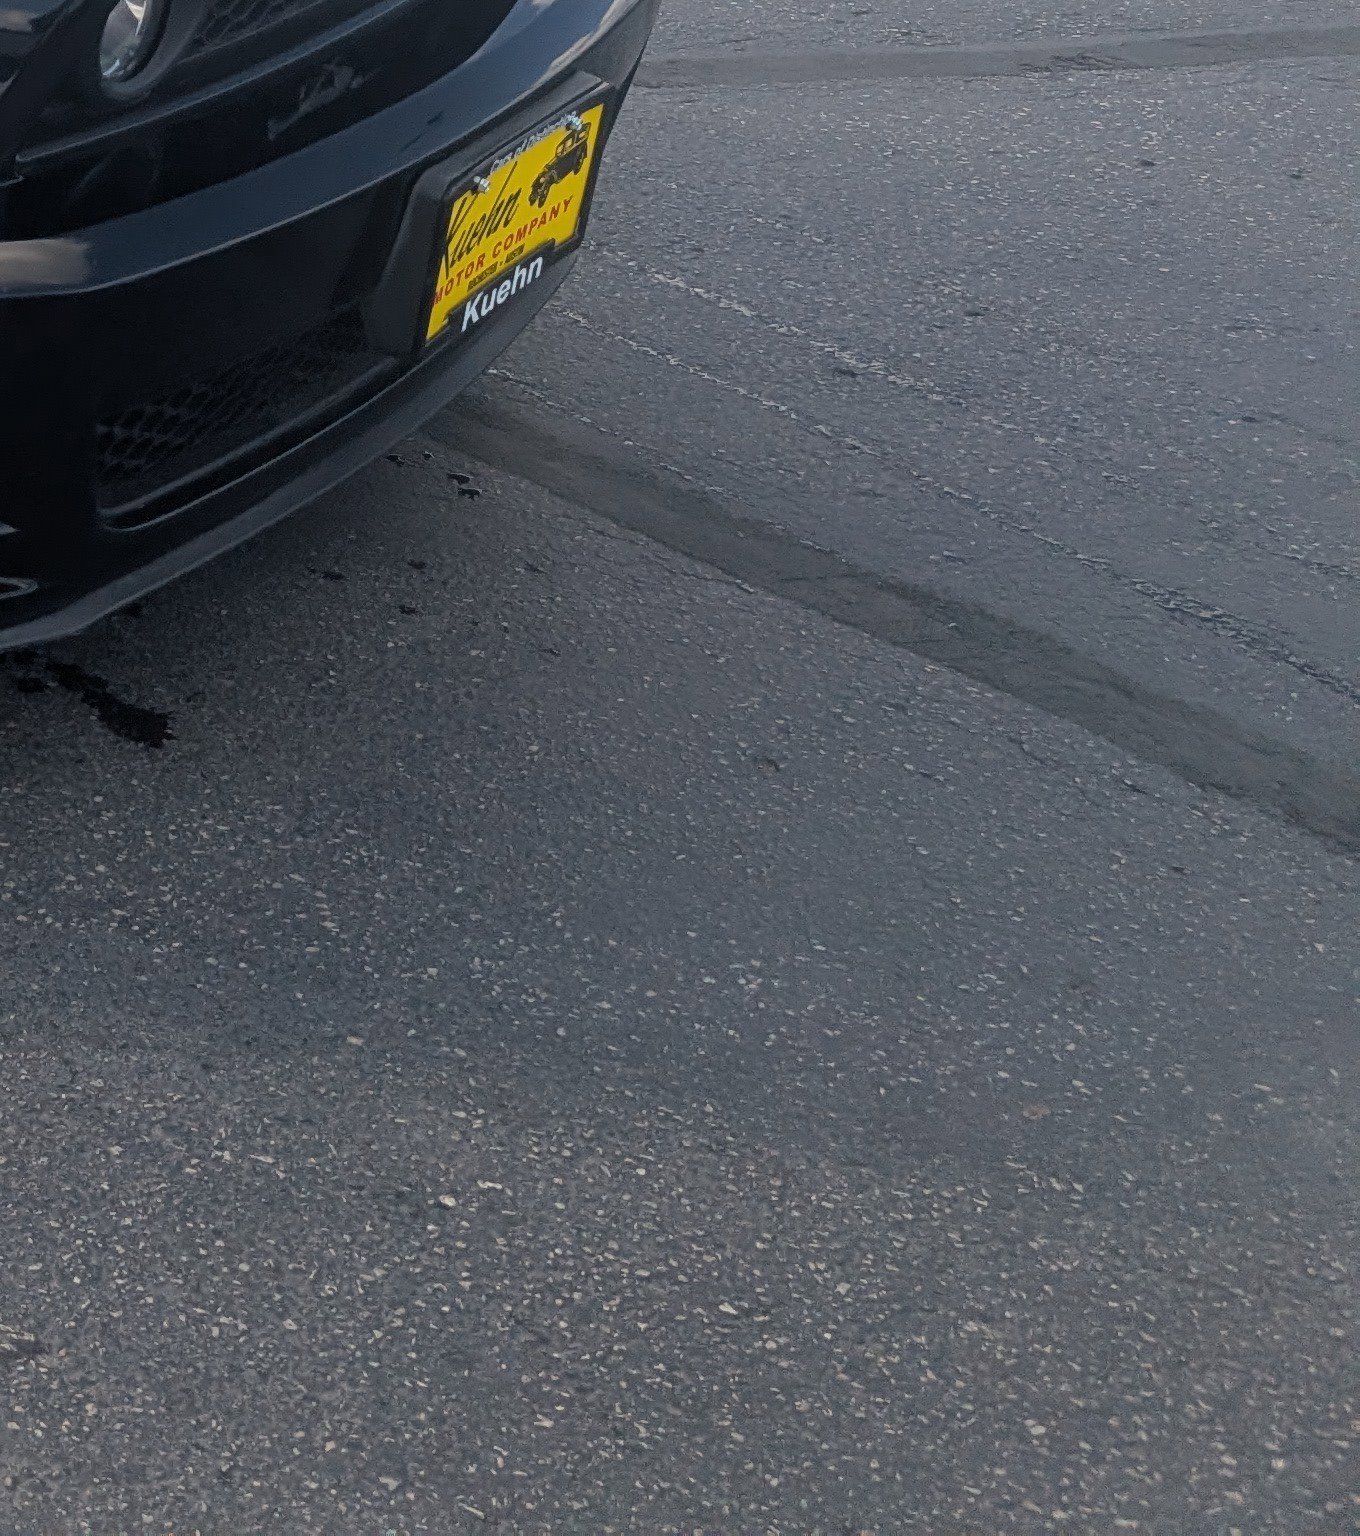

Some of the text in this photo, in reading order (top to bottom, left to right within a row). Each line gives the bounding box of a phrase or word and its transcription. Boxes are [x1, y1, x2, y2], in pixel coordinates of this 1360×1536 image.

[432, 252, 486, 306] MOTOR
[492, 195, 573, 259] COMPANY
[444, 160, 522, 280] Kuehn
[460, 256, 544, 333] Kuehn
